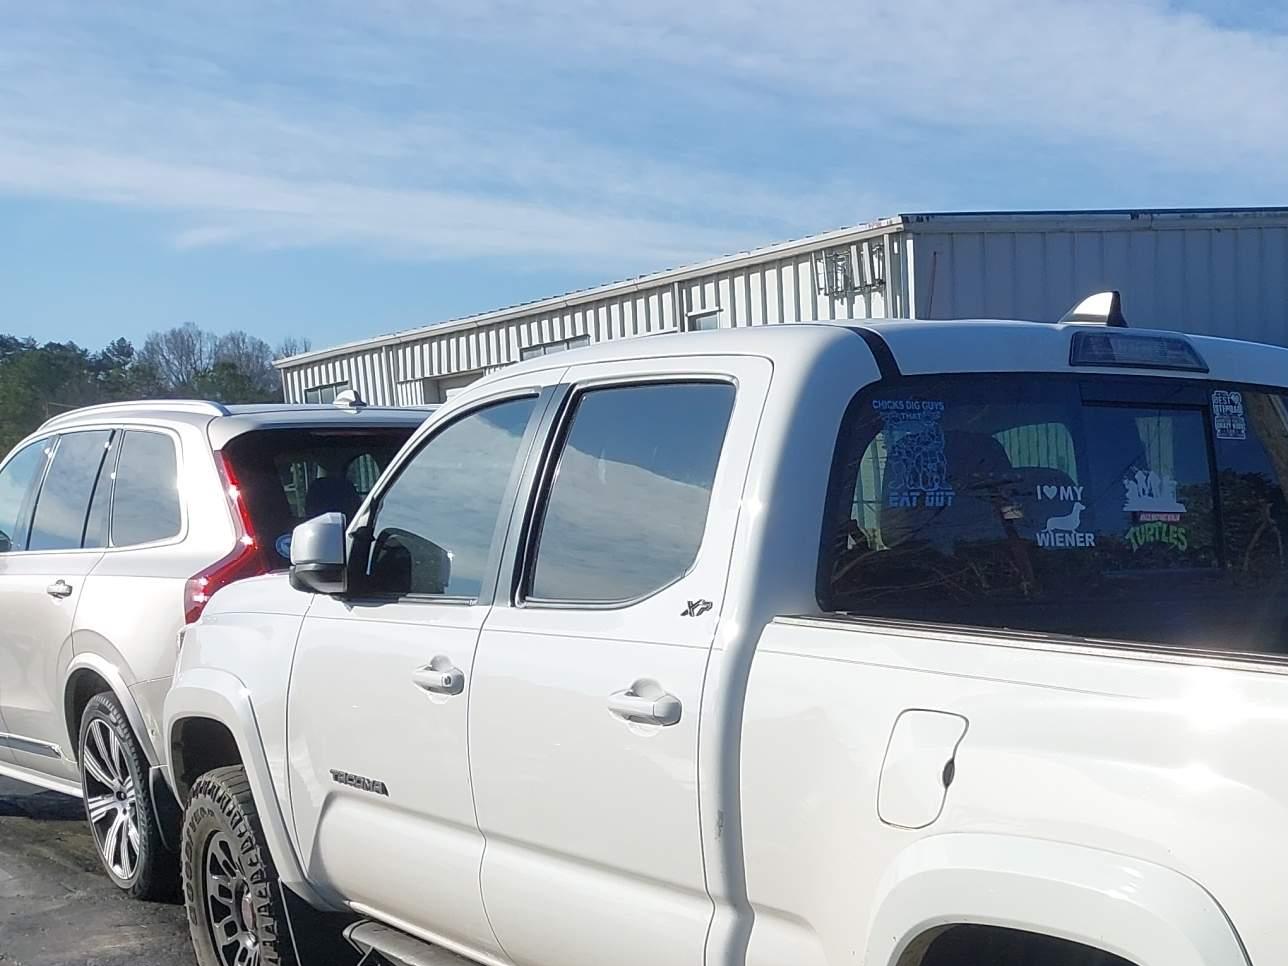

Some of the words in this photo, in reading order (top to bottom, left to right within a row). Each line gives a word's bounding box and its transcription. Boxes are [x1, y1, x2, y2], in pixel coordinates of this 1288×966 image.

[872, 400, 904, 410] CHICKS
[905, 401, 920, 410] DIG
[921, 401, 944, 411] GUYS
[901, 412, 921, 420] THAT
[888, 491, 918, 507] EAT
[925, 491, 955, 507] OUT
[1036, 485, 1042, 500] I
[1059, 486, 1084, 501] MY
[1036, 533, 1096, 547] WIENER
[1125, 520, 1188, 552] TURTLES
[329, 768, 389, 797] TACOMA
[185, 806, 215, 926] GOODYEAR
